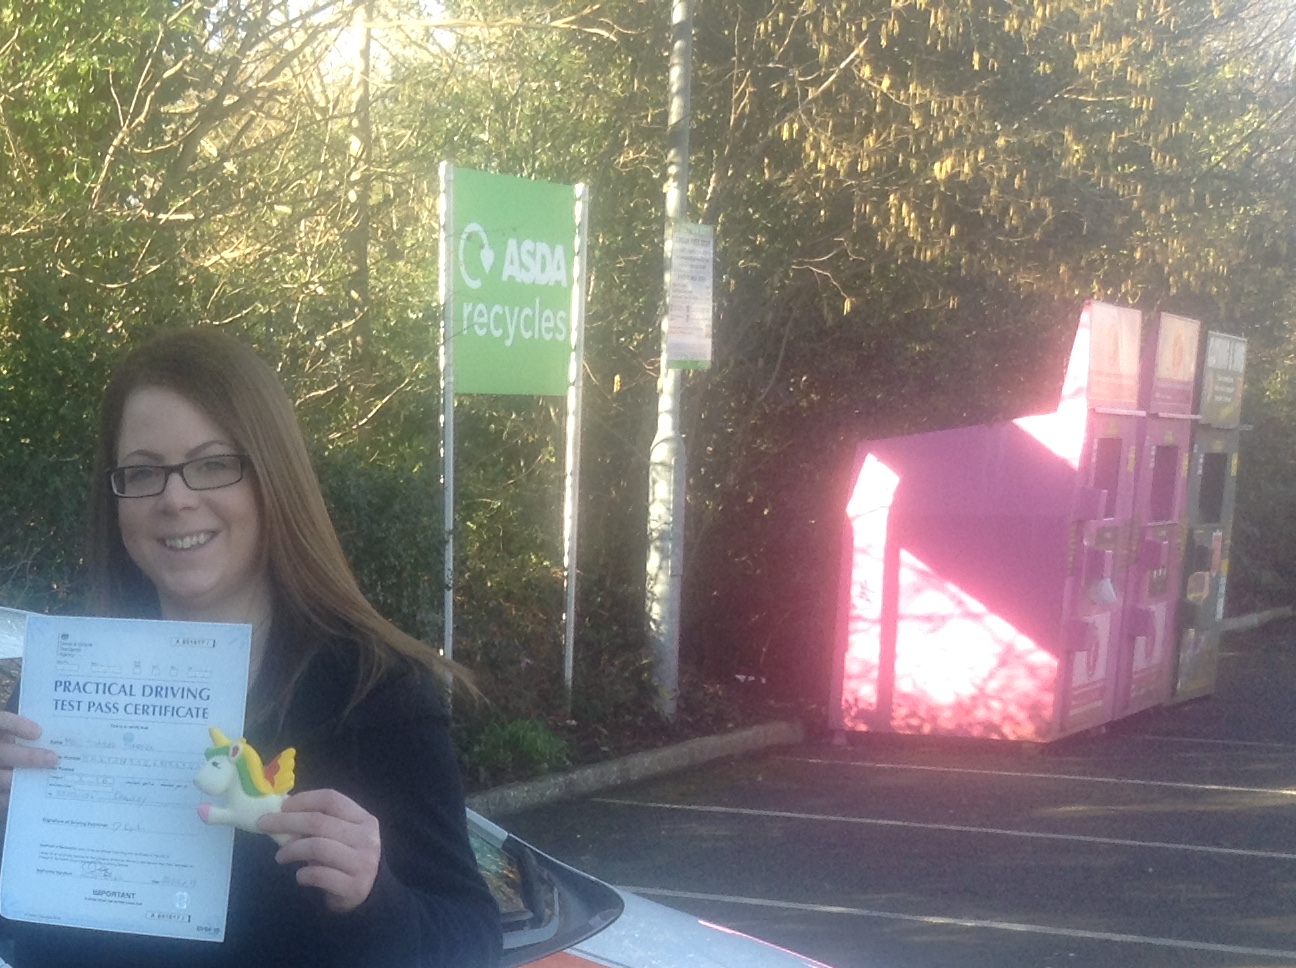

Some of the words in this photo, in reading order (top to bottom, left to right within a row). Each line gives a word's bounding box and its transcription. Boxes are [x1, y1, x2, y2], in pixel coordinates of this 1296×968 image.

[501, 237, 568, 288] ASDA
[462, 296, 568, 347] recycles
[52, 697, 83, 713] TEST
[86, 700, 121, 716] PASS
[123, 702, 210, 720] CERTIFICATE
[53, 678, 137, 699] PRACTICAL
[141, 683, 211, 702] DRIVING
